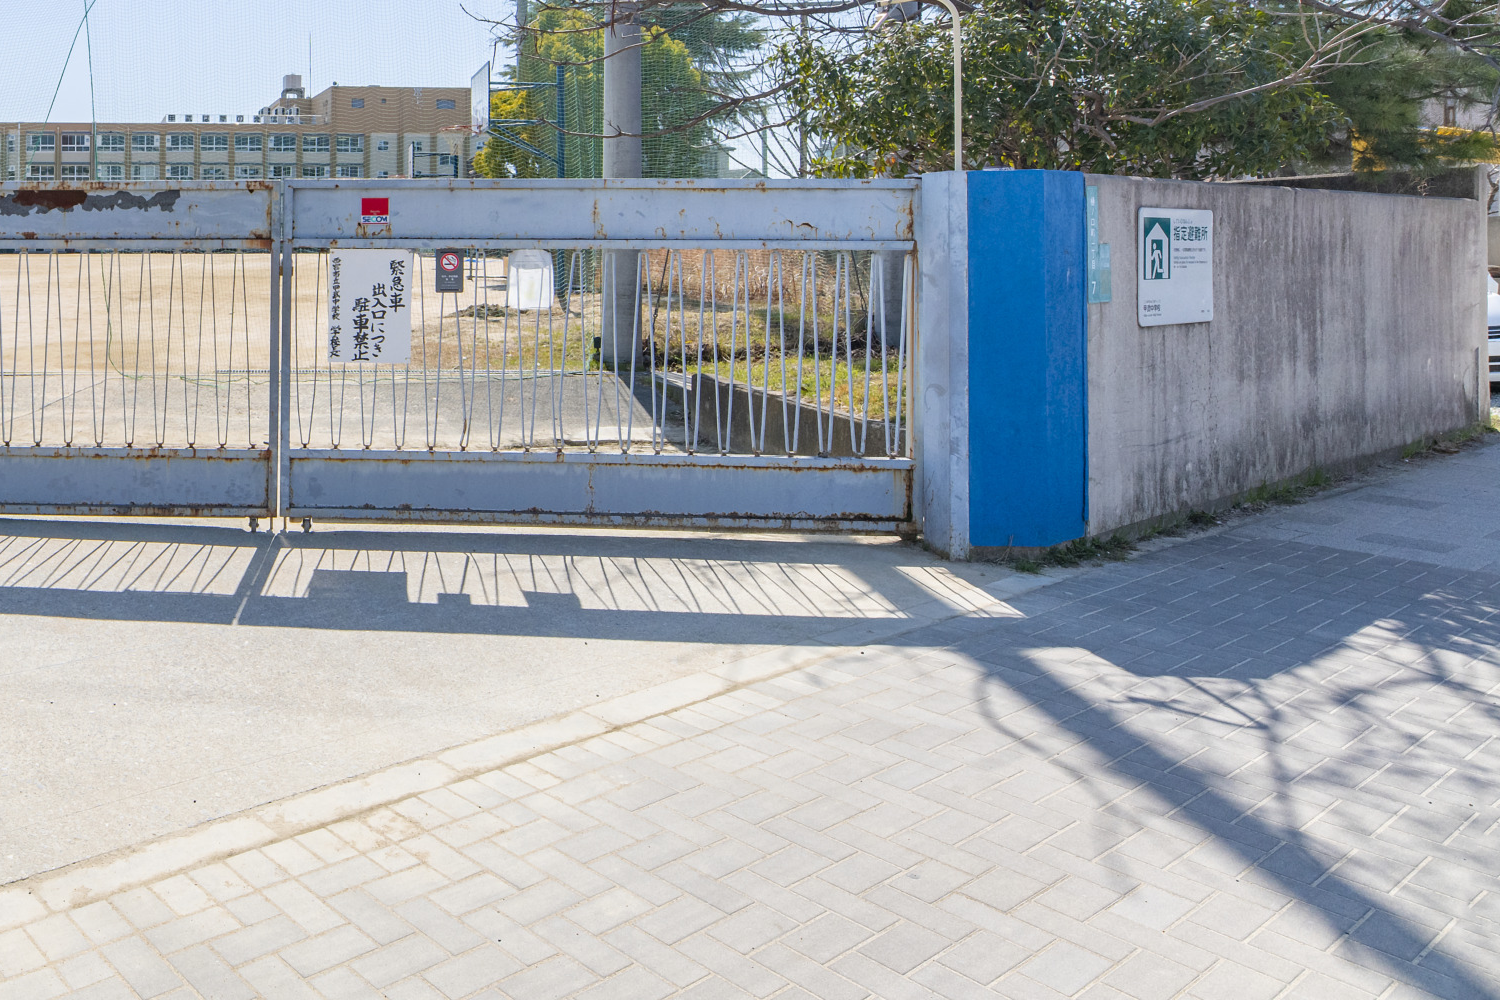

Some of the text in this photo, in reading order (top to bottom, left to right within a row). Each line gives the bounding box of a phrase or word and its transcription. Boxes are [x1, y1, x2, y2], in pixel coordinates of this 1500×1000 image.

[362, 215, 388, 223] SECOM
[1173, 226, 1208, 241] 指定避難所
[389, 260, 405, 312] 緊急車
[1091, 281, 1097, 295] 7
[352, 298, 370, 361] 駐車禁止
[371, 283, 387, 357] 出入口につき
